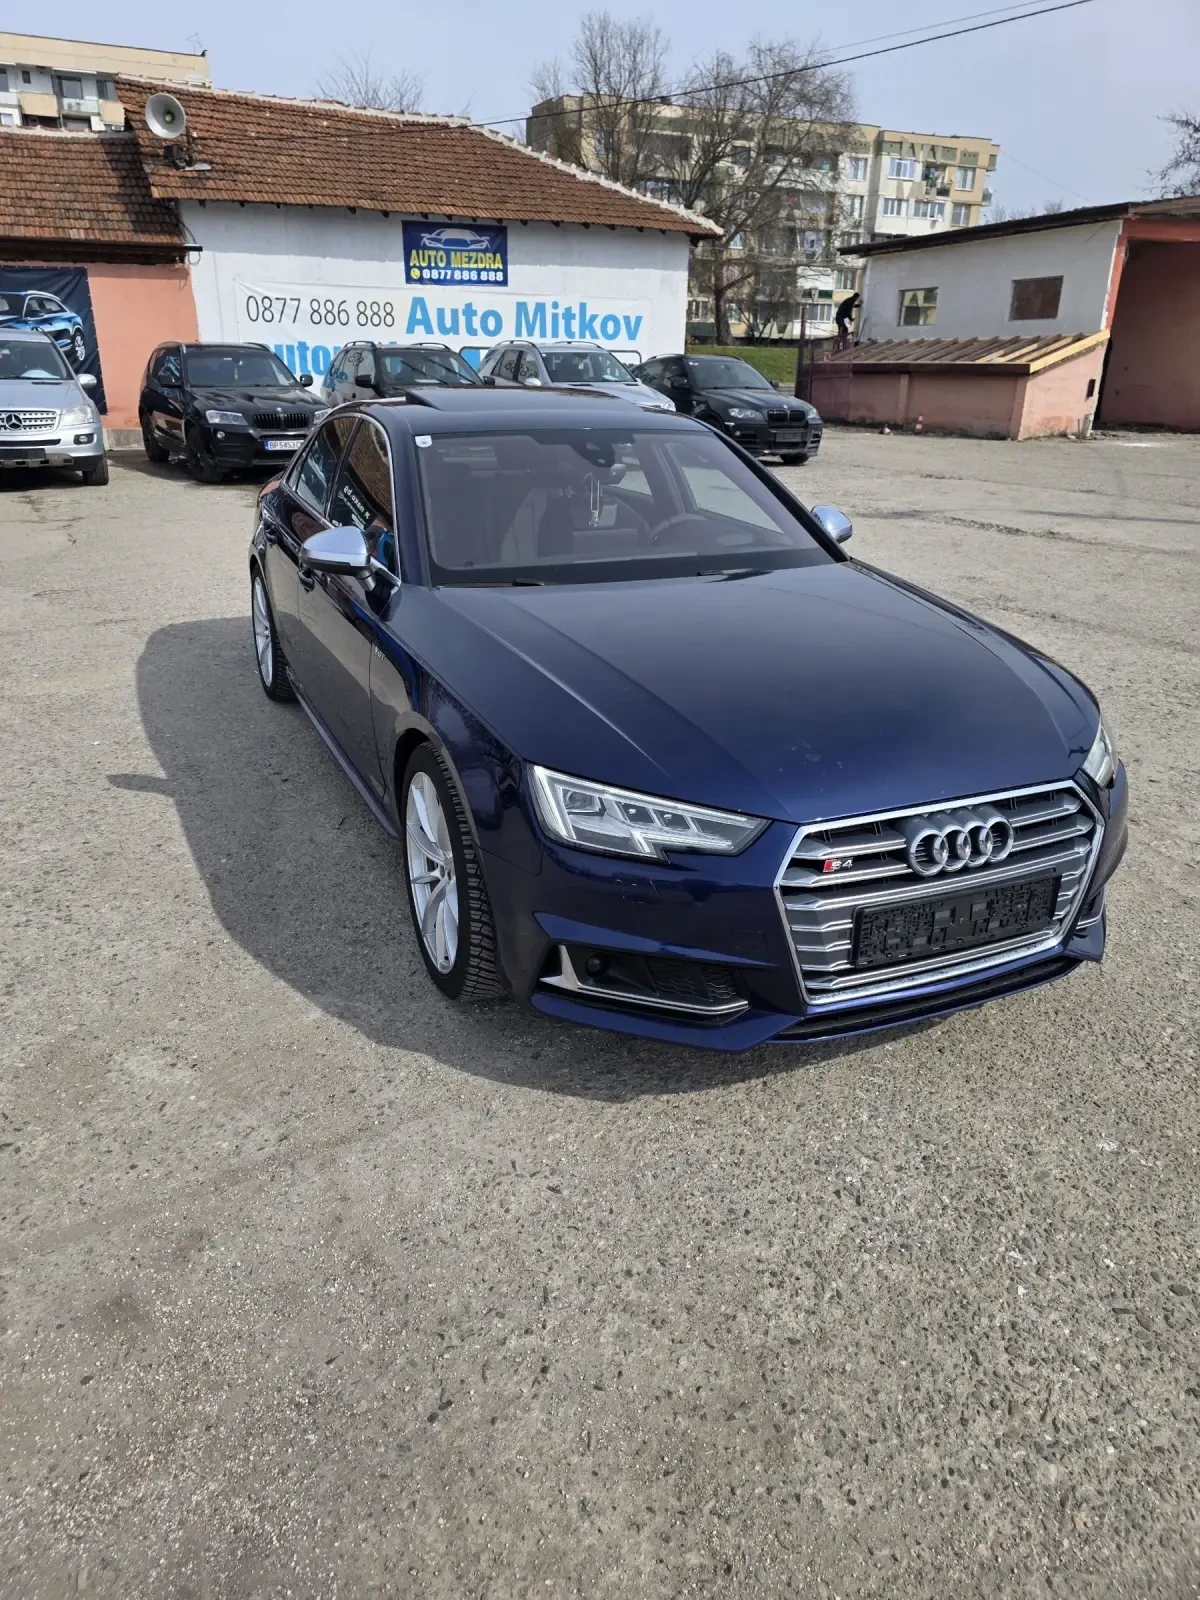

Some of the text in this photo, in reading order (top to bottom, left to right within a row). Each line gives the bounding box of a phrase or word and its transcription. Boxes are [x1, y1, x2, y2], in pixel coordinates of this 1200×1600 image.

[409, 249, 504, 269] AUTO MEZDRA
[422, 268, 504, 281] 0877 886 888
[246, 295, 395, 328] 0877 886 888
[405, 296, 643, 341] Auto Mitkov
[831, 859, 853, 871] S4
